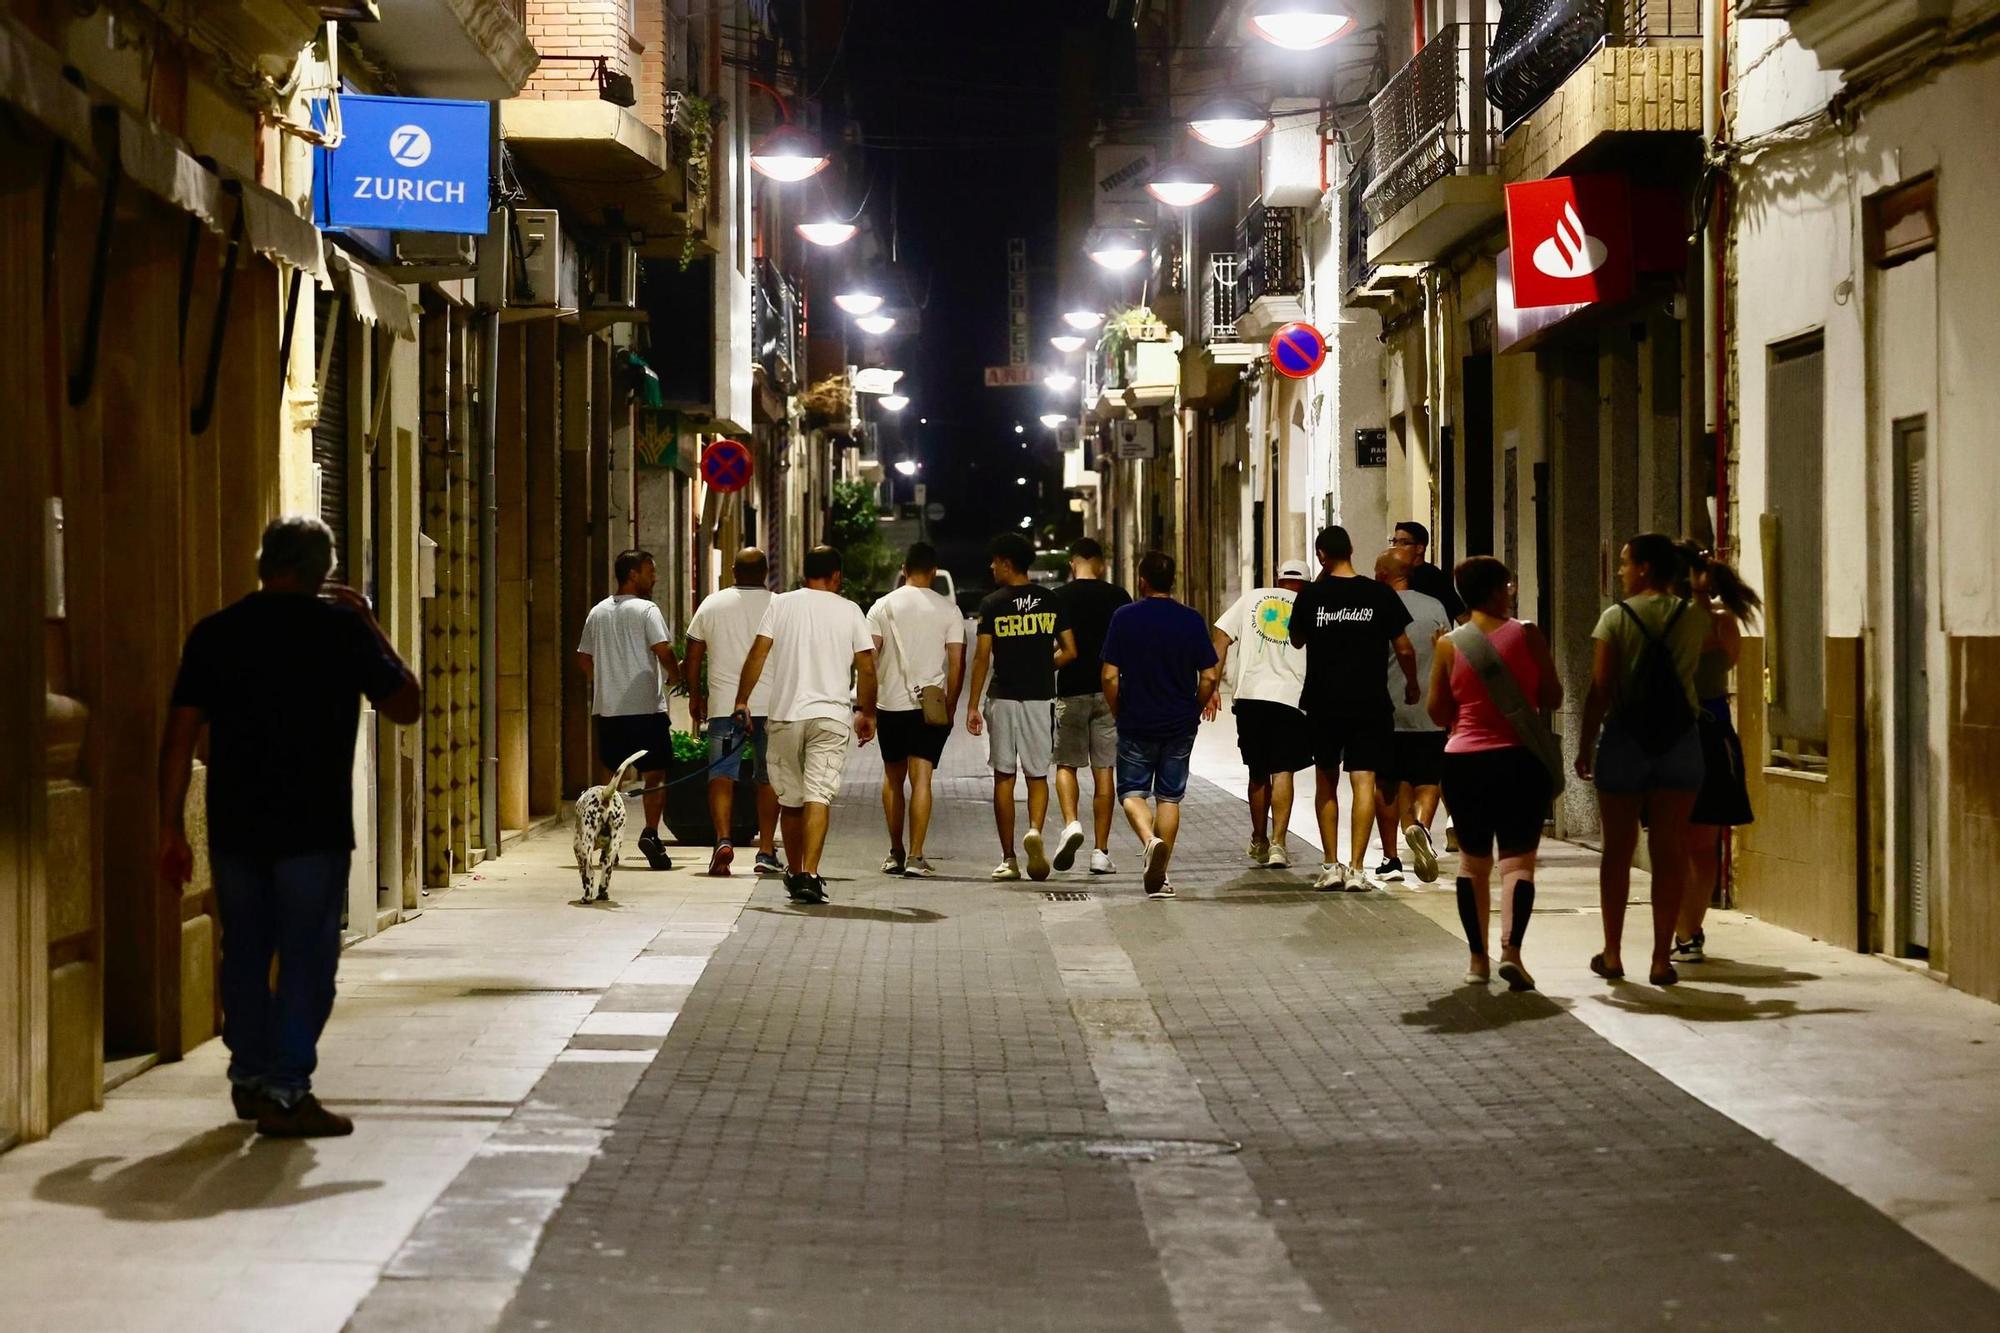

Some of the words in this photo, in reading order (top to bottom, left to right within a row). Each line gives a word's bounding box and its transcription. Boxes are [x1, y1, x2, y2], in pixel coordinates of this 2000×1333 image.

[395, 132, 425, 160] Z
[353, 176, 465, 204] ZURICH
[994, 612, 1057, 638] GROW
